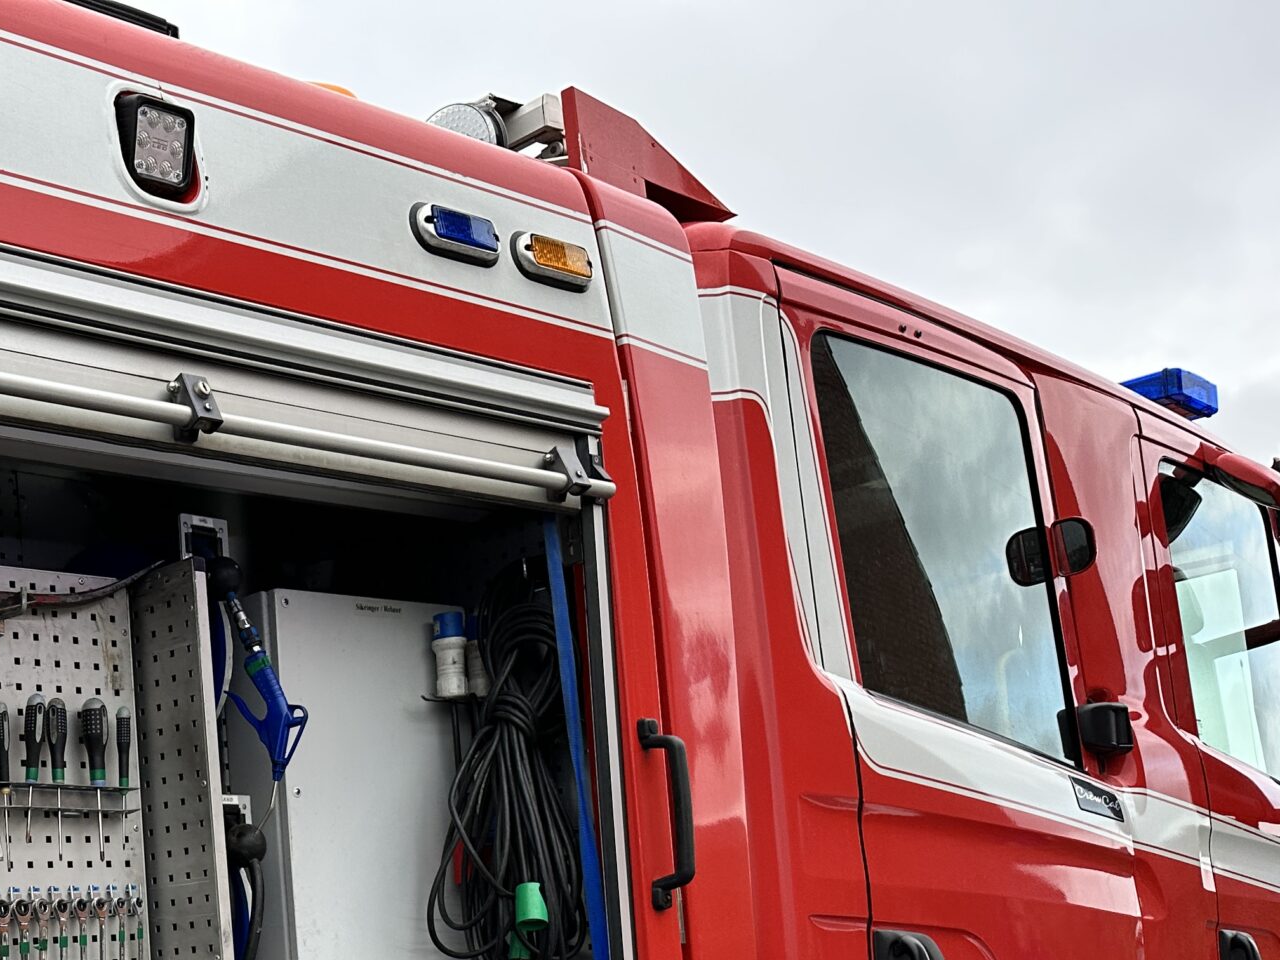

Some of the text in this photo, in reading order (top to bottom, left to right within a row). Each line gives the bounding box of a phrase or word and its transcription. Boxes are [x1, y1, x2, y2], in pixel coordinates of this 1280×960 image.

[152, 143, 168, 151] LED
[1076, 785, 1121, 811] Crew Cab
